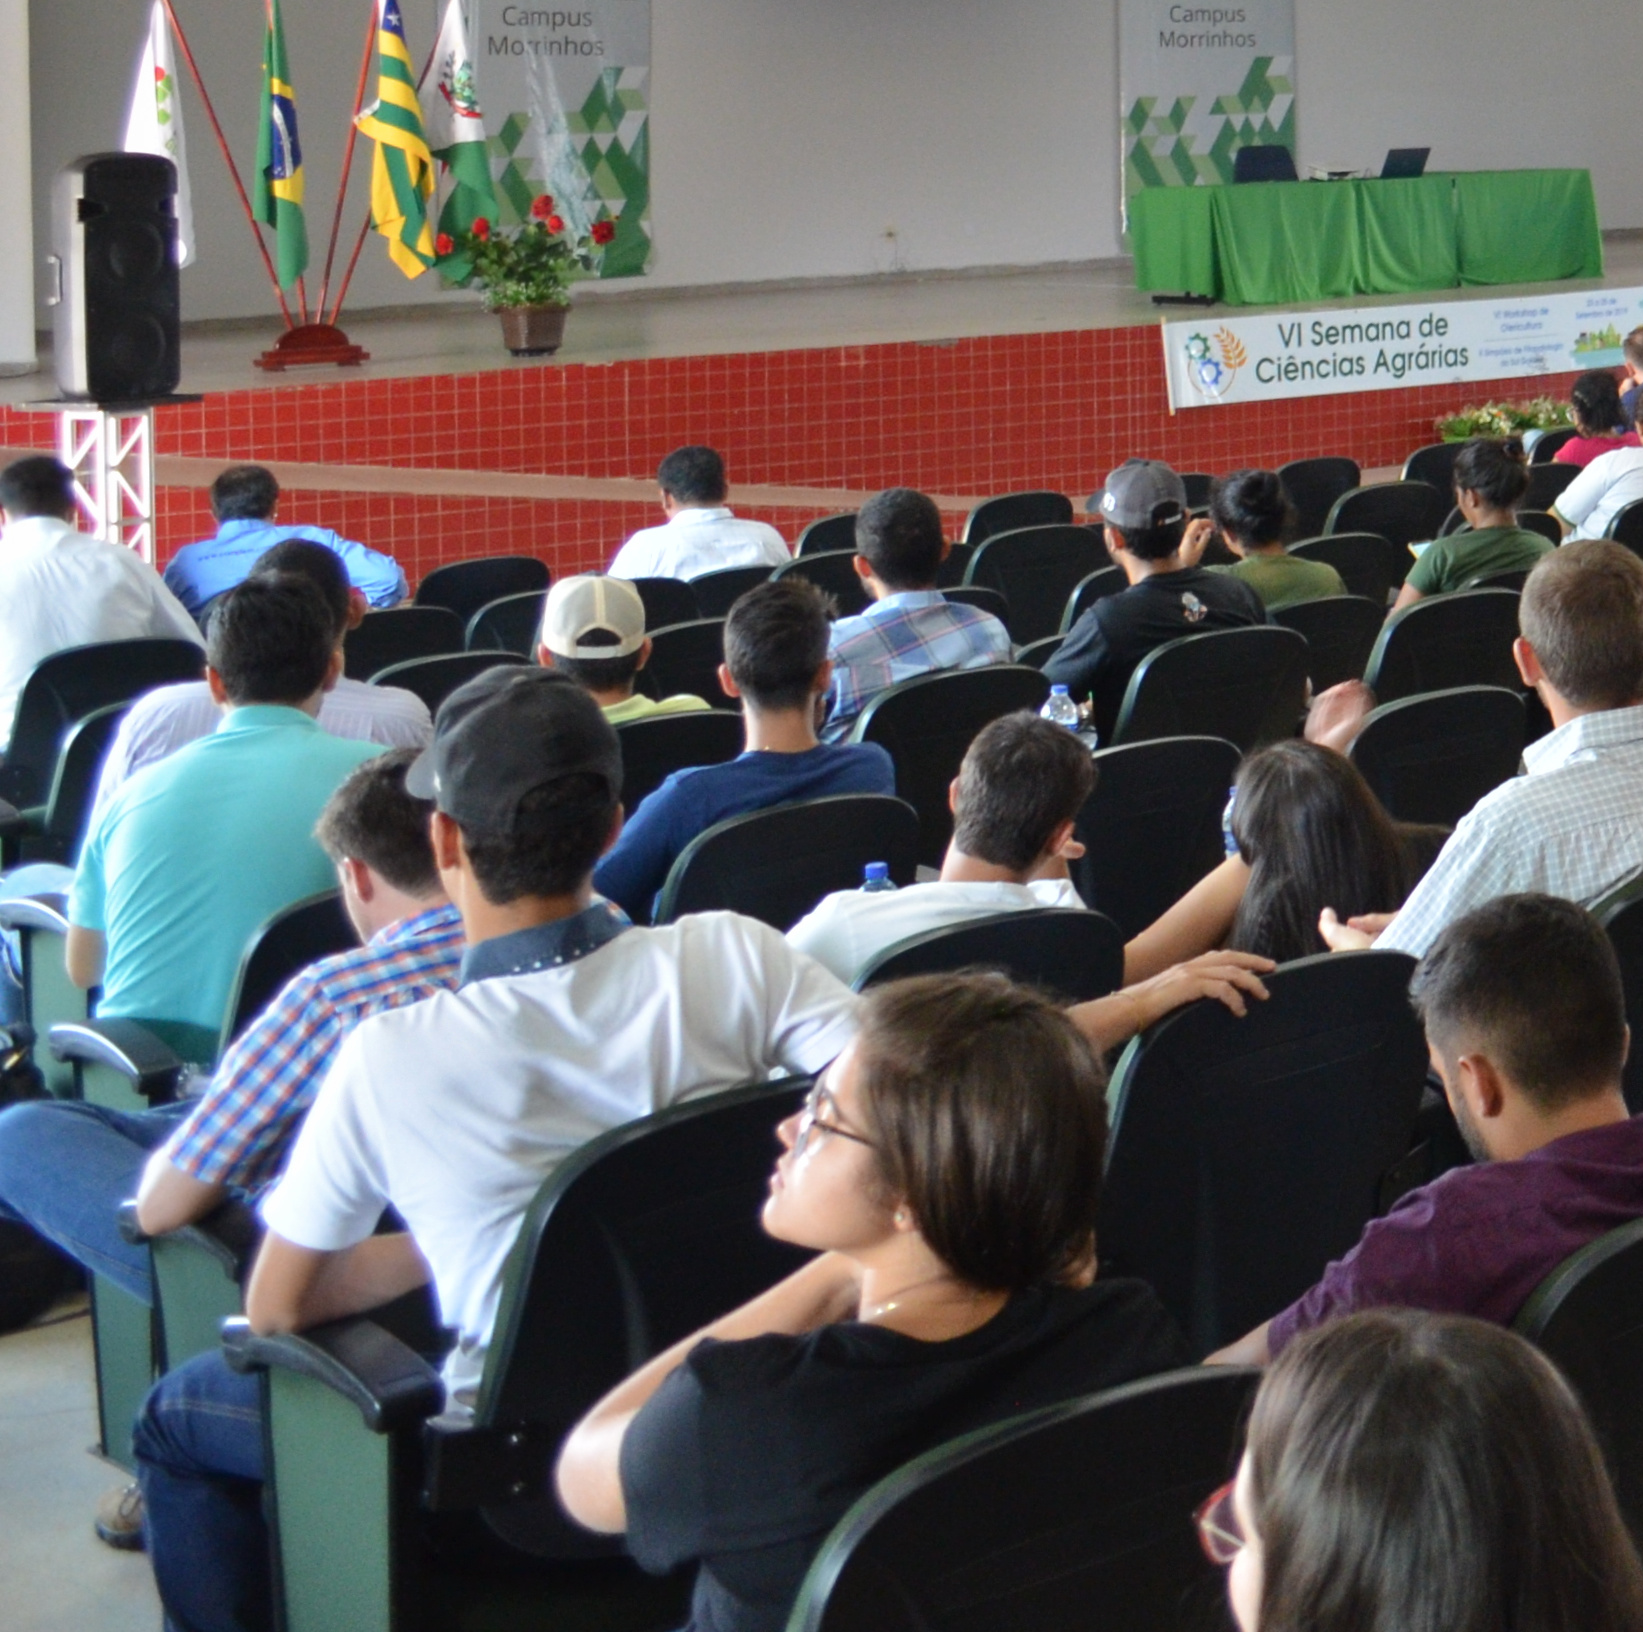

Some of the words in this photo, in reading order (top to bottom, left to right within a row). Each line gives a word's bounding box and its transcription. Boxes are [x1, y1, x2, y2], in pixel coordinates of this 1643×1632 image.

[502, 6, 593, 31] Campus
[1169, 5, 1246, 27] Campus
[488, 36, 605, 56] Morrinhos
[1159, 30, 1257, 48] Morrinhos
[1278, 323, 1302, 348] VI
[1311, 318, 1411, 346] Semana
[1418, 312, 1448, 337] de
[1256, 351, 1366, 384] Ciências
[1373, 343, 1469, 379] Agrárias
